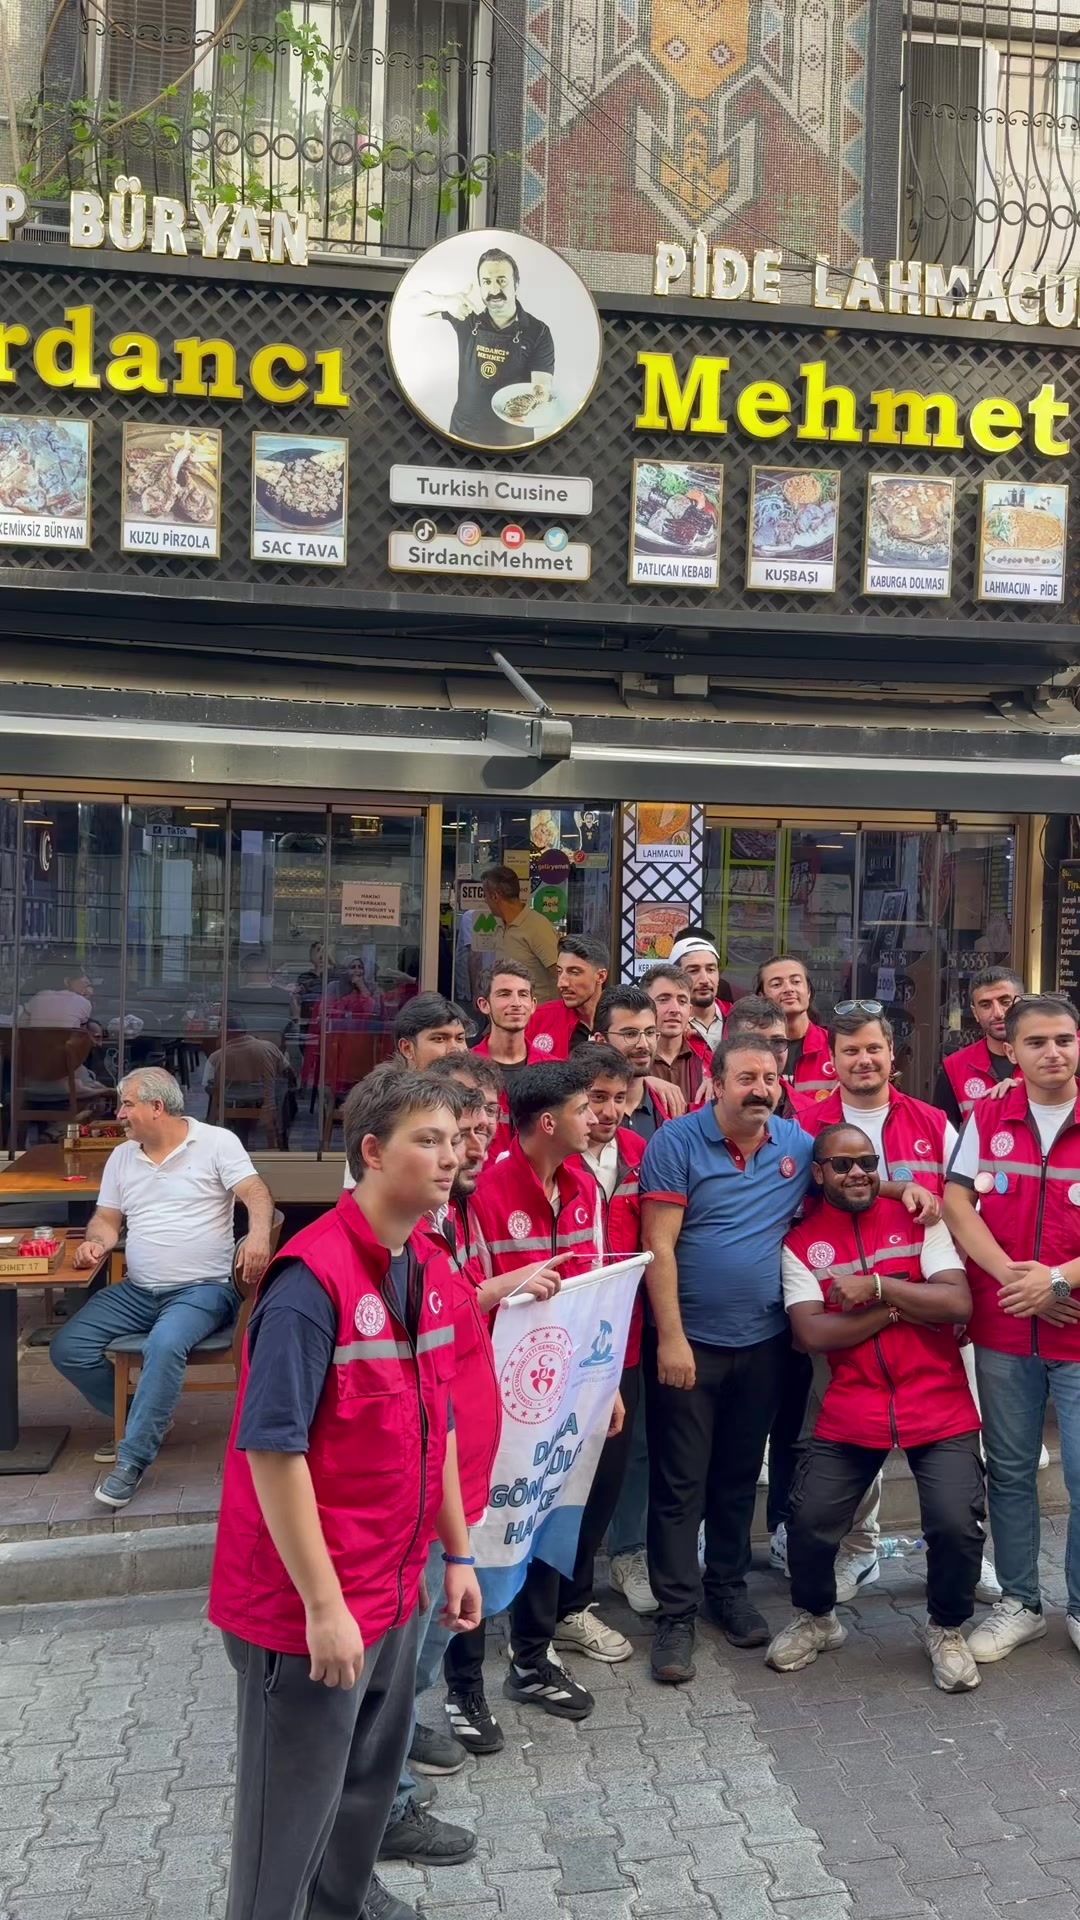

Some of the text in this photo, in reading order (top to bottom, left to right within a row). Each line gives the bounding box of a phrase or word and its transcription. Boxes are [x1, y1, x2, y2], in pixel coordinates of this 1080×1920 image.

[70, 174, 309, 266] BÜRYAN
[654, 229, 1080, 329] PİDE LAHMACU
[635, 351, 1070, 457] Mehmet
[417, 477, 489, 498] Turkish
[44, 521, 83, 539] BÜRYAN
[130, 530, 210, 548] KUZU PİRZOLA
[262, 540, 339, 558] SAC TAVA
[408, 546, 573, 571] SirdanciMehmet
[637, 562, 712, 579] PATLICAN KEBABI
[765, 569, 818, 584] KUŞBAŞI
[870, 575, 945, 590] KABURGA DOLMASI
[985, 580, 1030, 595] LAHMACUN
[1040, 580, 1058, 596] PİDE
[643, 849, 684, 858] LAHMACUN
[462, 886, 486, 898] SETC
